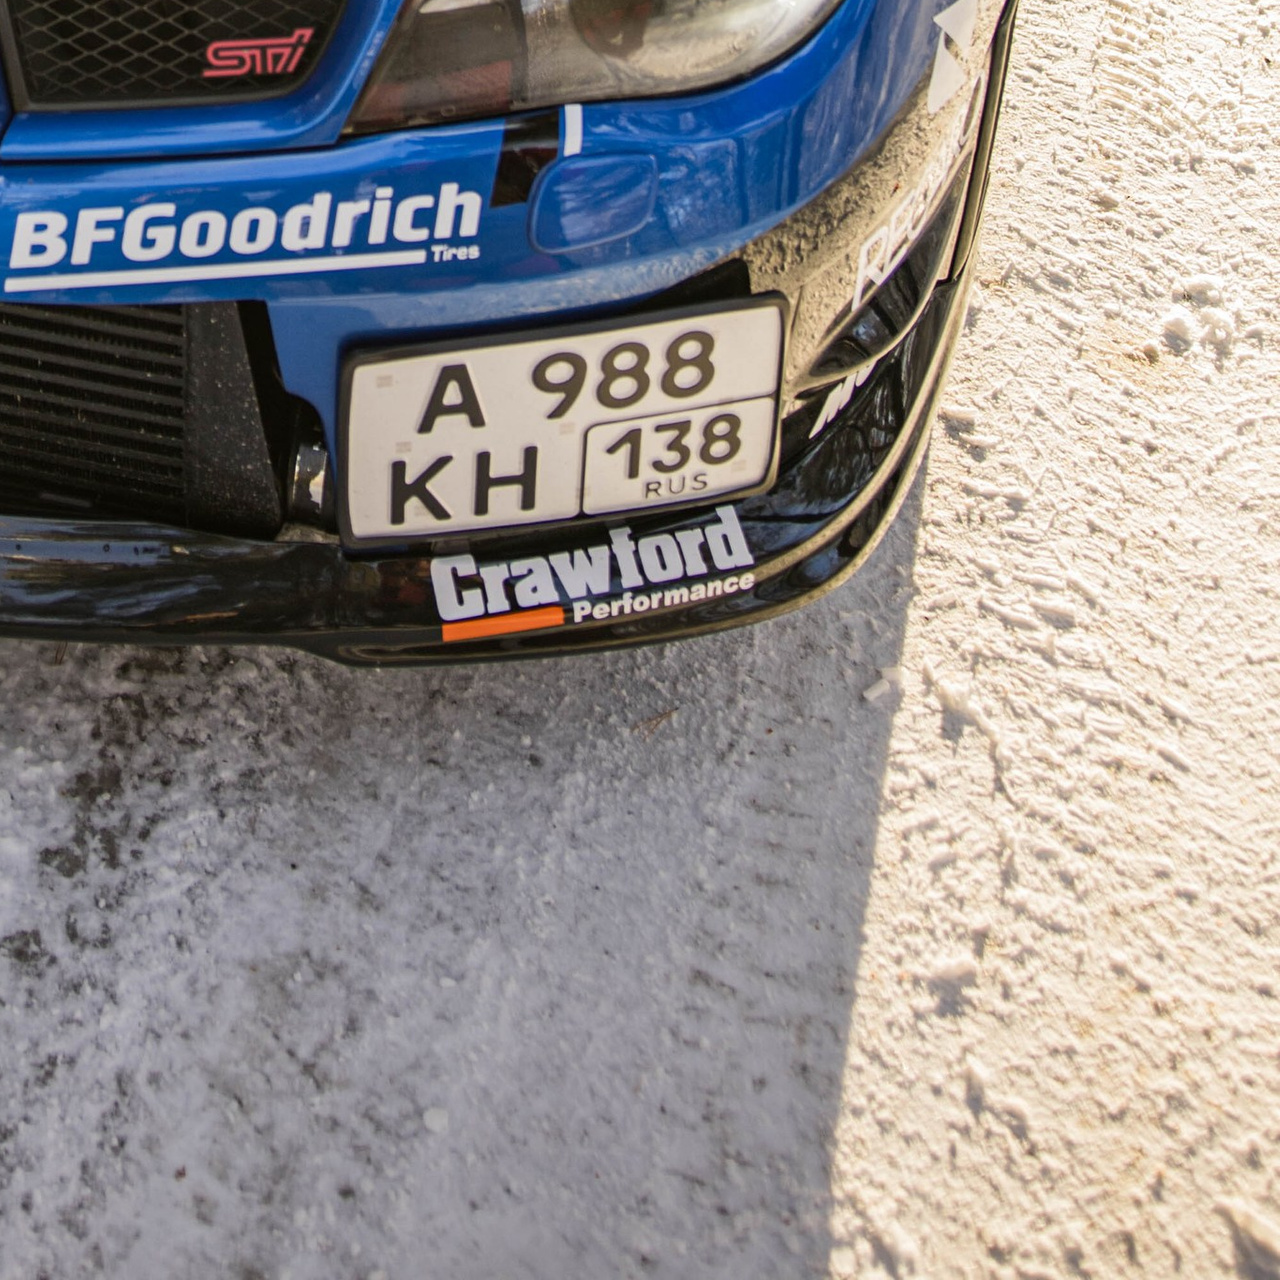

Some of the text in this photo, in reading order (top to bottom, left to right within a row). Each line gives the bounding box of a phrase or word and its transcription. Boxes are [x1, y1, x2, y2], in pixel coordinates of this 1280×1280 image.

[9, 182, 482, 269] BFGoodrich
[851, 68, 987, 313] RECO
[430, 244, 480, 263] Tires
[417, 363, 486, 434] A
[531, 330, 715, 420] 988
[389, 413, 742, 526] KH 138
[644, 473, 709, 499] RUS
[430, 505, 755, 622] Crawford
[573, 572, 756, 624] Performance
